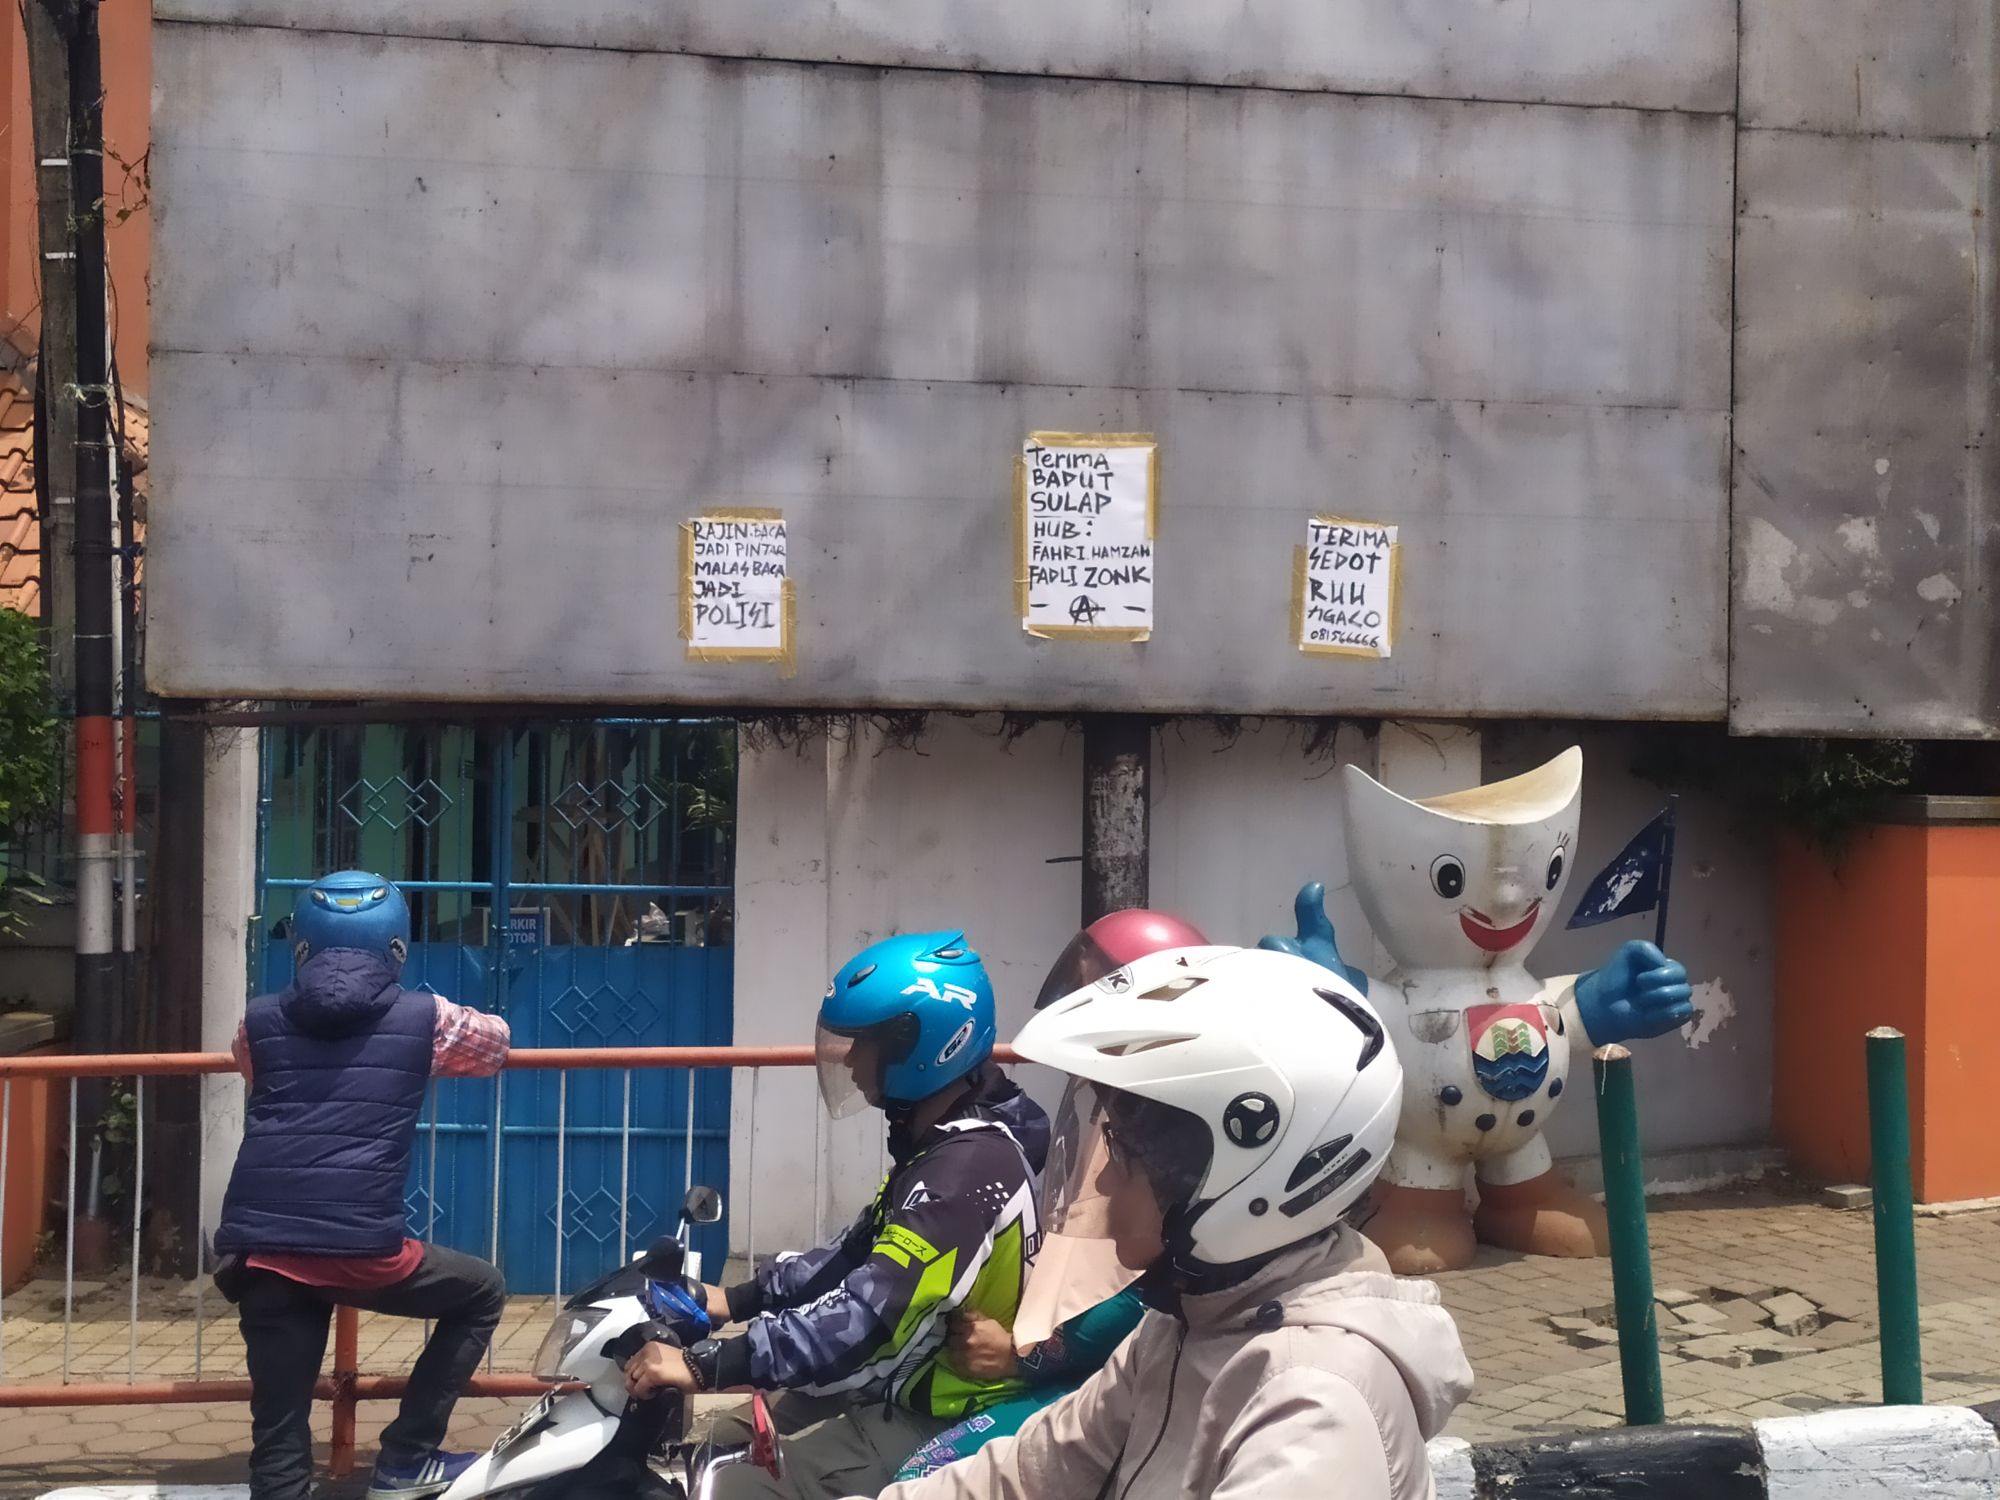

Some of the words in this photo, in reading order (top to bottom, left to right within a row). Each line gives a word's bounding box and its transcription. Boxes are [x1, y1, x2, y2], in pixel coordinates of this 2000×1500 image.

[1032, 468, 1114, 490] BADUT
[1030, 491, 1112, 514] SULAP
[693, 521, 748, 541] RAJIN
[1310, 524, 1391, 548] TERIMA
[695, 543, 729, 556] JADI
[736, 543, 786, 557] PINTAR
[1032, 545, 1085, 562] FAHRI
[1092, 544, 1150, 560] HAMZAH
[1308, 547, 1381, 574] SEDOT
[694, 561, 750, 577] MALAS
[1029, 565, 1077, 590] FADLI
[1084, 565, 1150, 588] ZONK
[693, 580, 744, 599] JADI
[1308, 577, 1365, 606] RUU
[693, 601, 775, 630] POLISI
